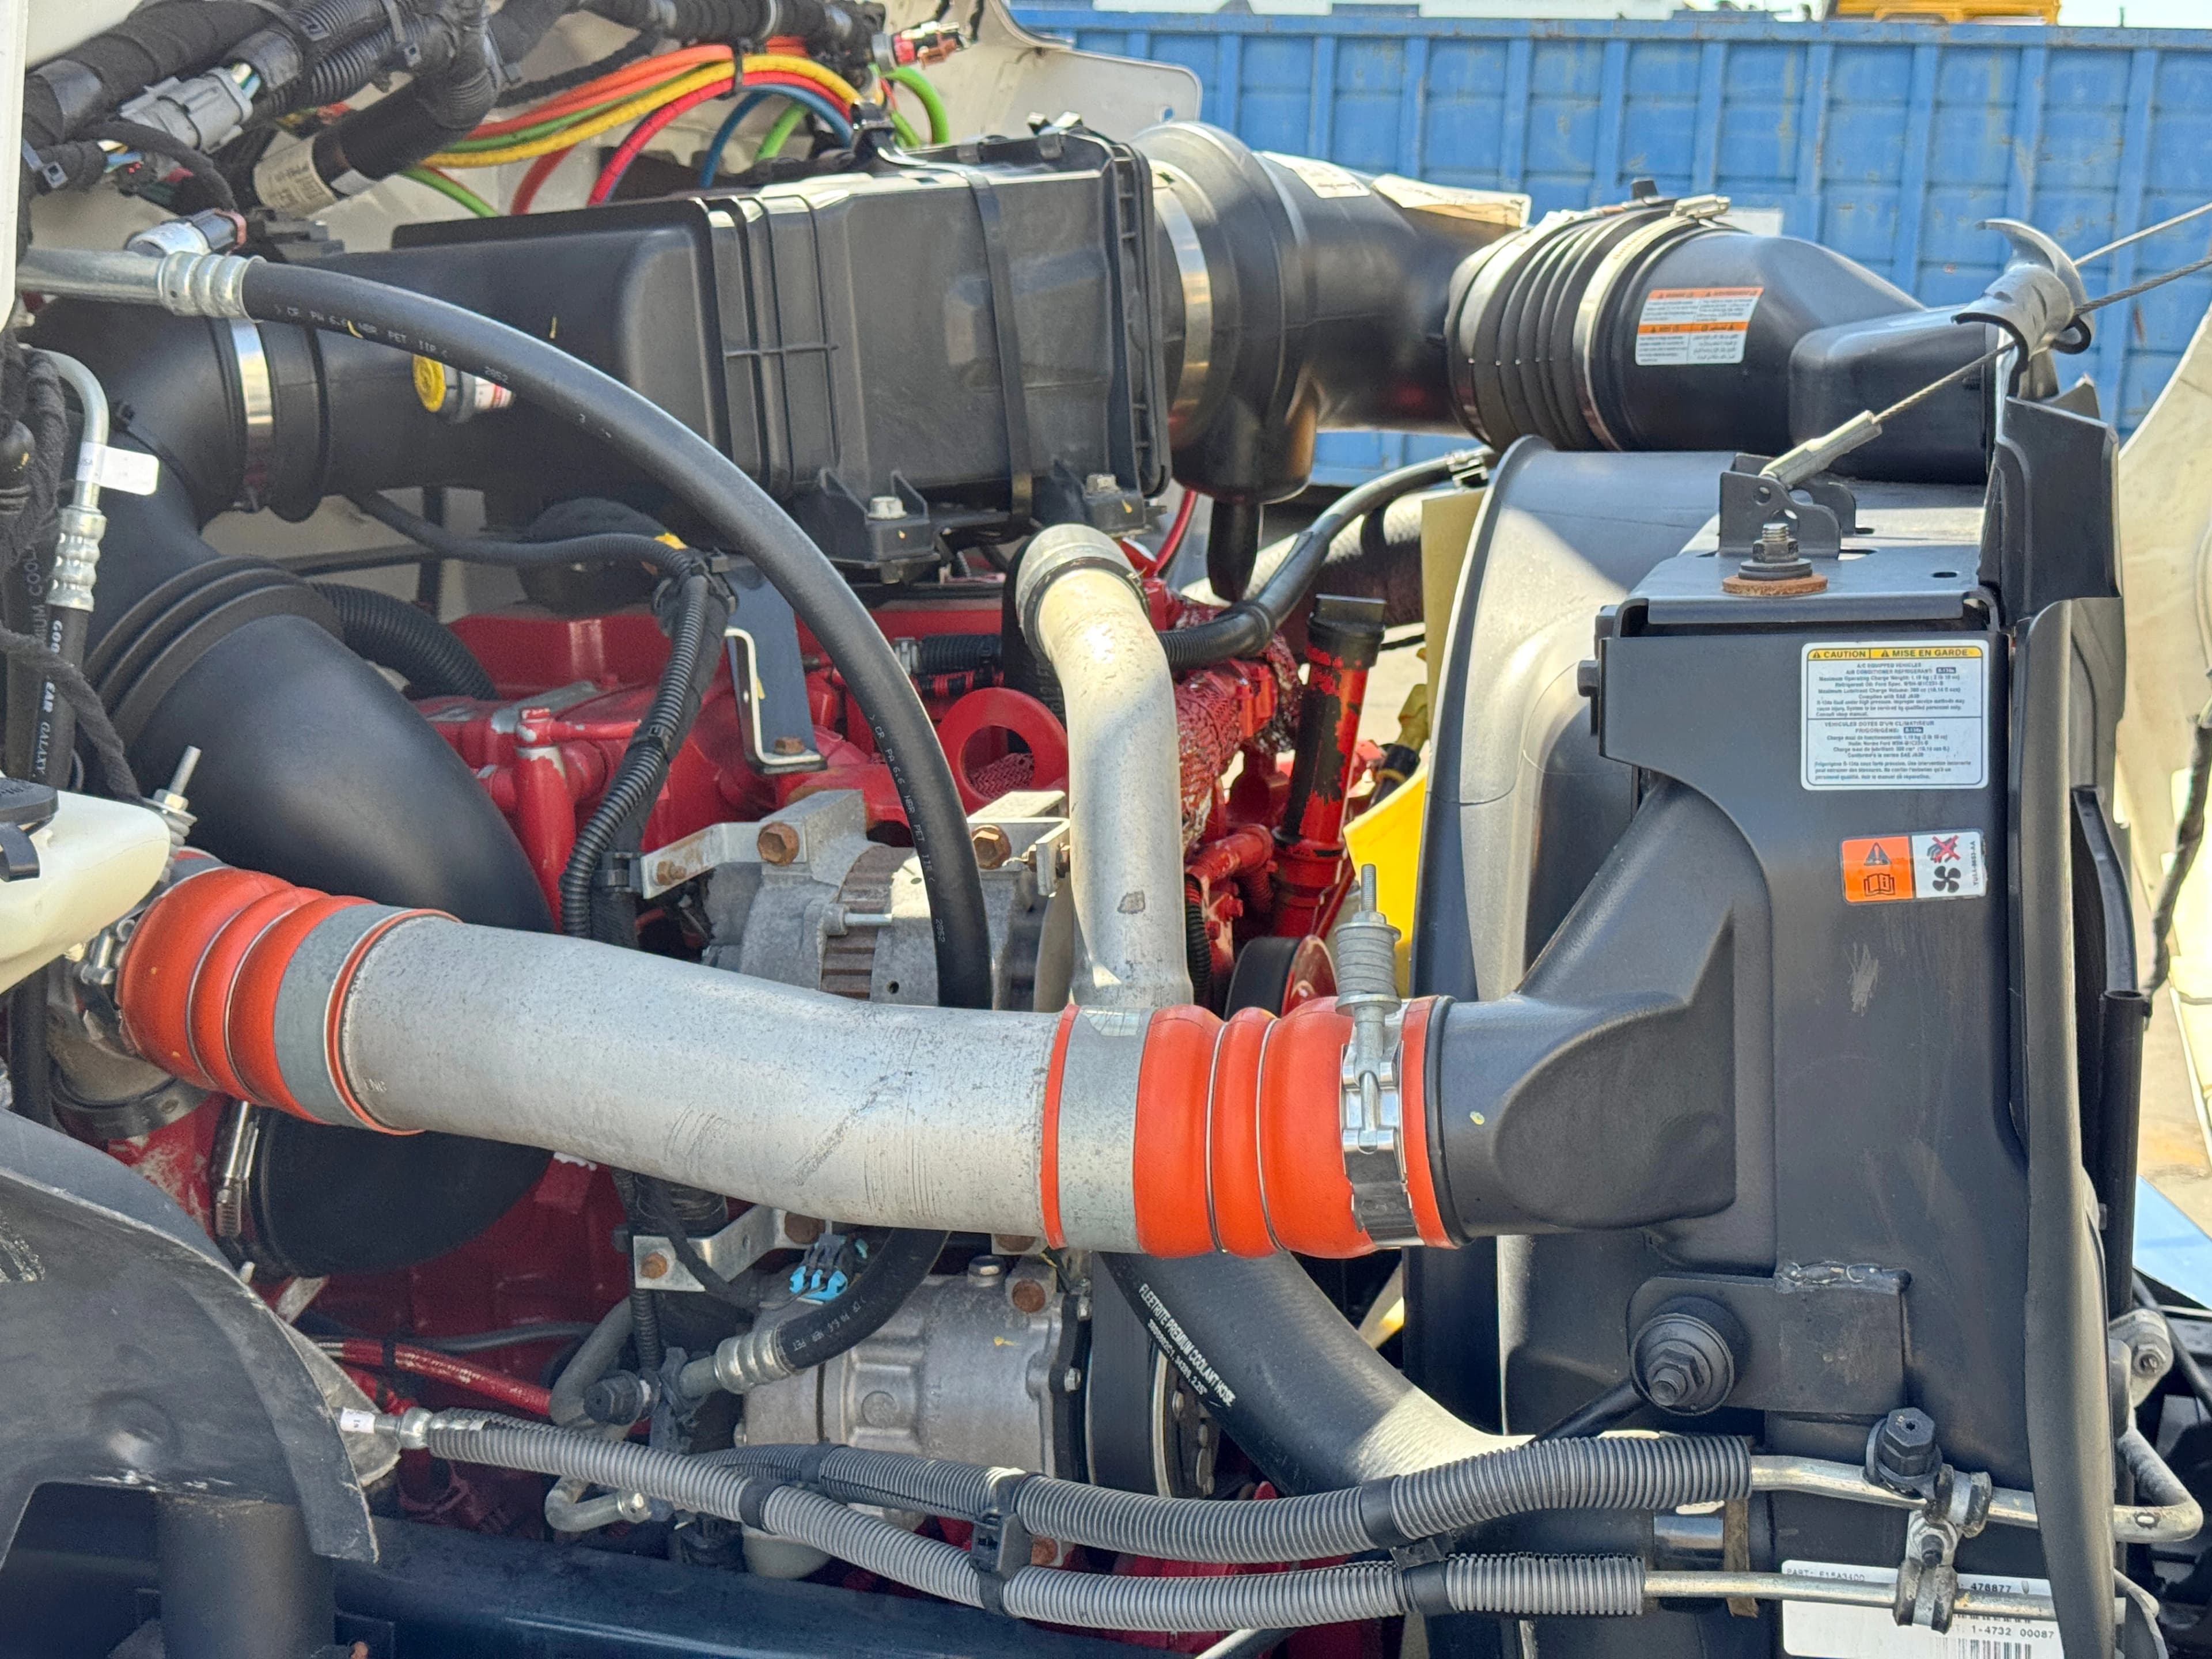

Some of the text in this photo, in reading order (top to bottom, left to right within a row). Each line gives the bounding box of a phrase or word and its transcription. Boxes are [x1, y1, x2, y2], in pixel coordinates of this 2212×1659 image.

[875, 726, 885, 738] CR
[885, 748, 895, 762] PA
[893, 767, 905, 784] 6.6
[904, 795, 915, 813] NBR
[914, 824, 925, 842] PET
[1139, 1283, 1236, 1407] FLEETRITE PREMIUM COOLANT HOSE
[1972, 1625, 2012, 1636] 1-4732
[2020, 1628, 2054, 1639] 00087
